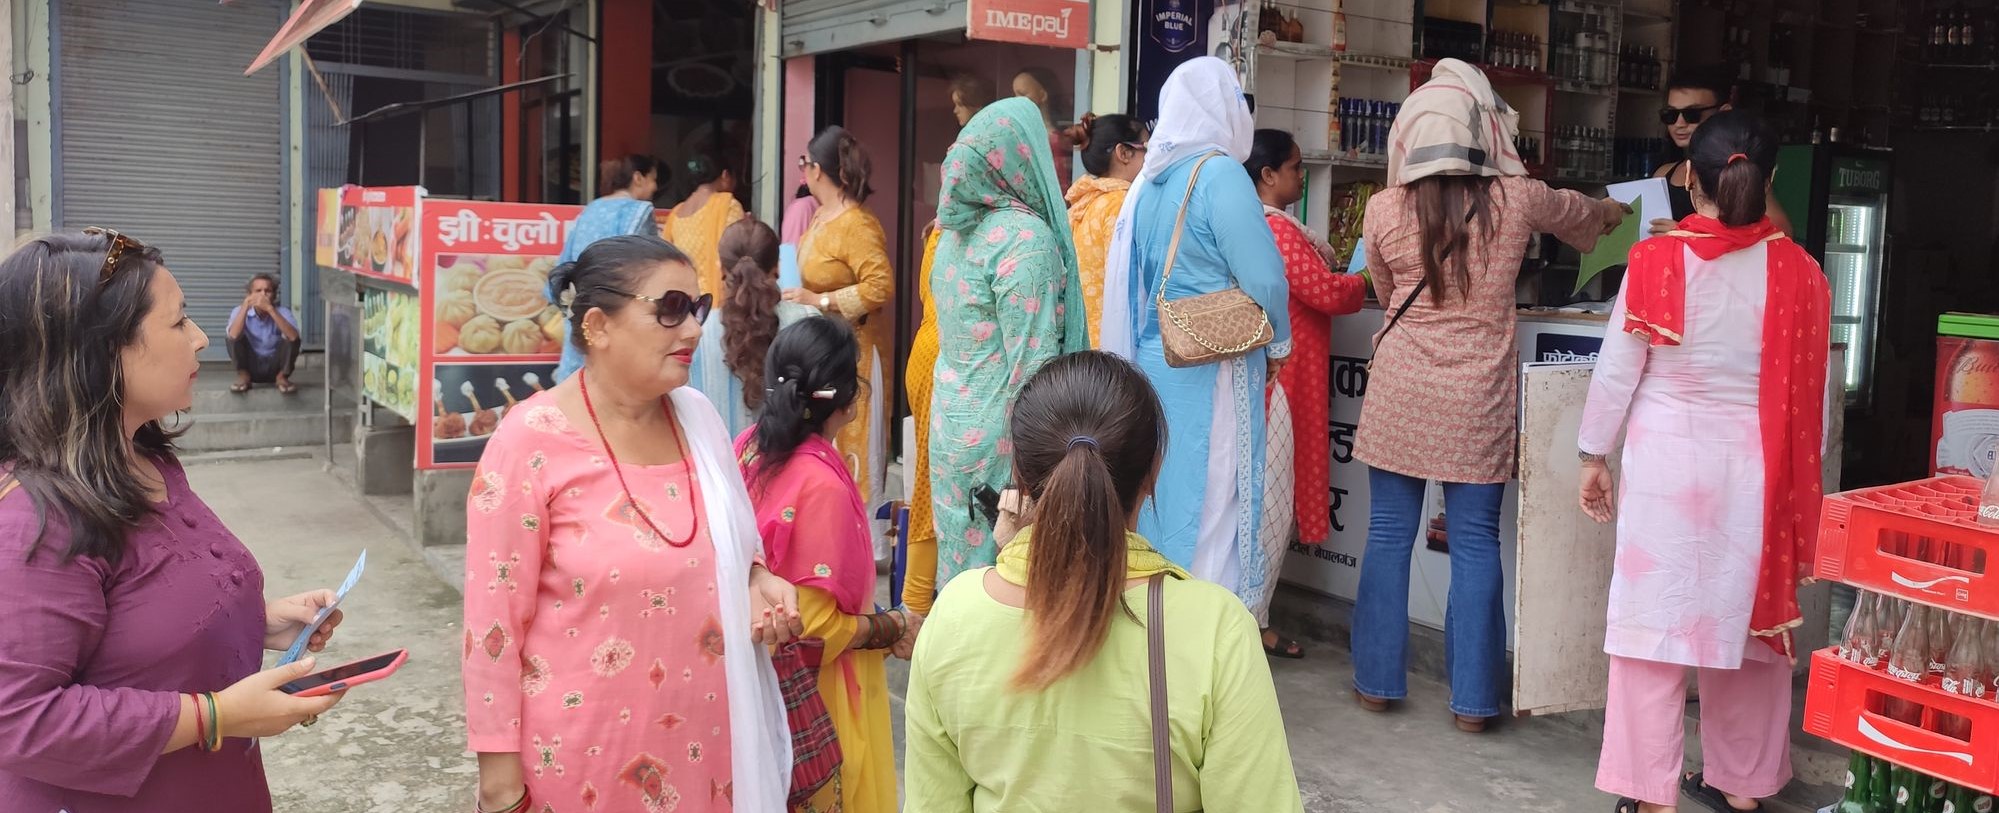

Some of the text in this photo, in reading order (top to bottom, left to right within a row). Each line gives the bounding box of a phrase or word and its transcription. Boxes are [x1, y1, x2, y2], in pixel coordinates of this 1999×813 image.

[1155, 11, 1193, 26] IMPERIAL
[1164, 21, 1184, 31] BLUE
[1838, 167, 1880, 190] TUBORG
